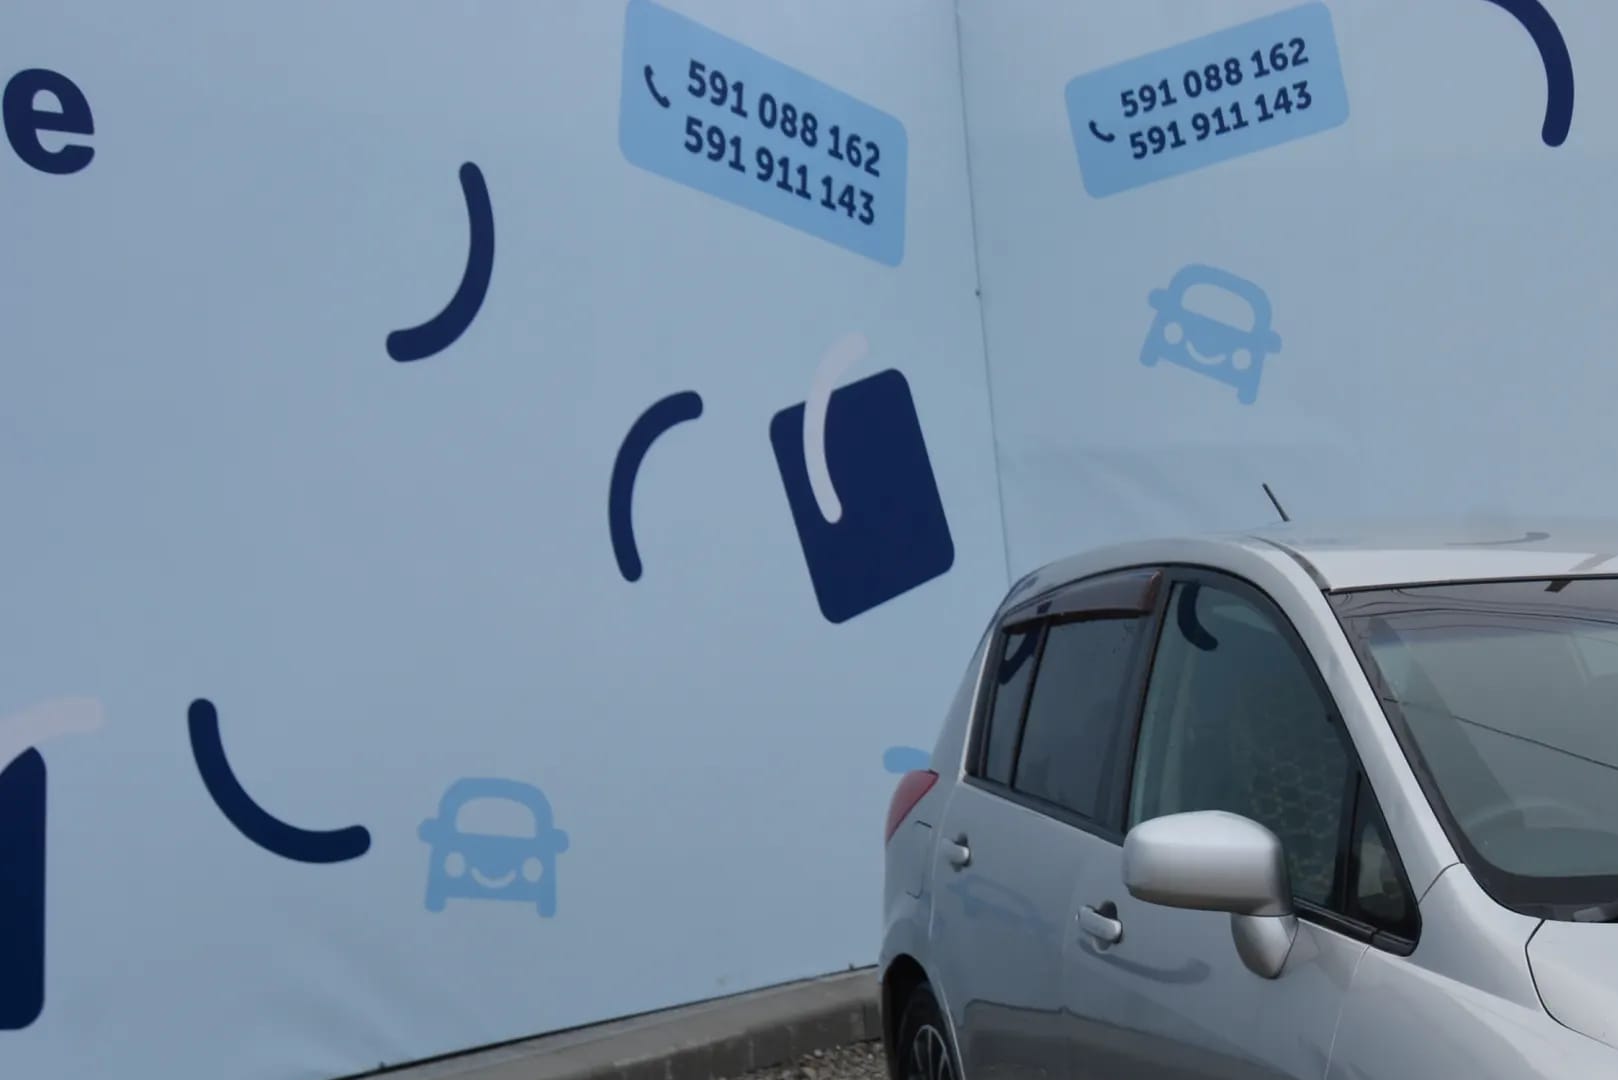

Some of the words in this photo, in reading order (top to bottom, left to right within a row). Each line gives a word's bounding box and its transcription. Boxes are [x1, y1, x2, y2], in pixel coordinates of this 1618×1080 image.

[686, 58, 749, 120] 591
[757, 92, 819, 150] 088
[826, 124, 881, 179] 162
[1119, 77, 1179, 119] 591
[1182, 56, 1244, 99] 088
[1249, 36, 1310, 80] 162
[1128, 119, 1188, 161] 591
[1190, 100, 1250, 143] 911
[1253, 79, 1313, 124] 143
[683, 114, 747, 175] 591
[754, 145, 813, 203] 911
[819, 173, 876, 227] 143
